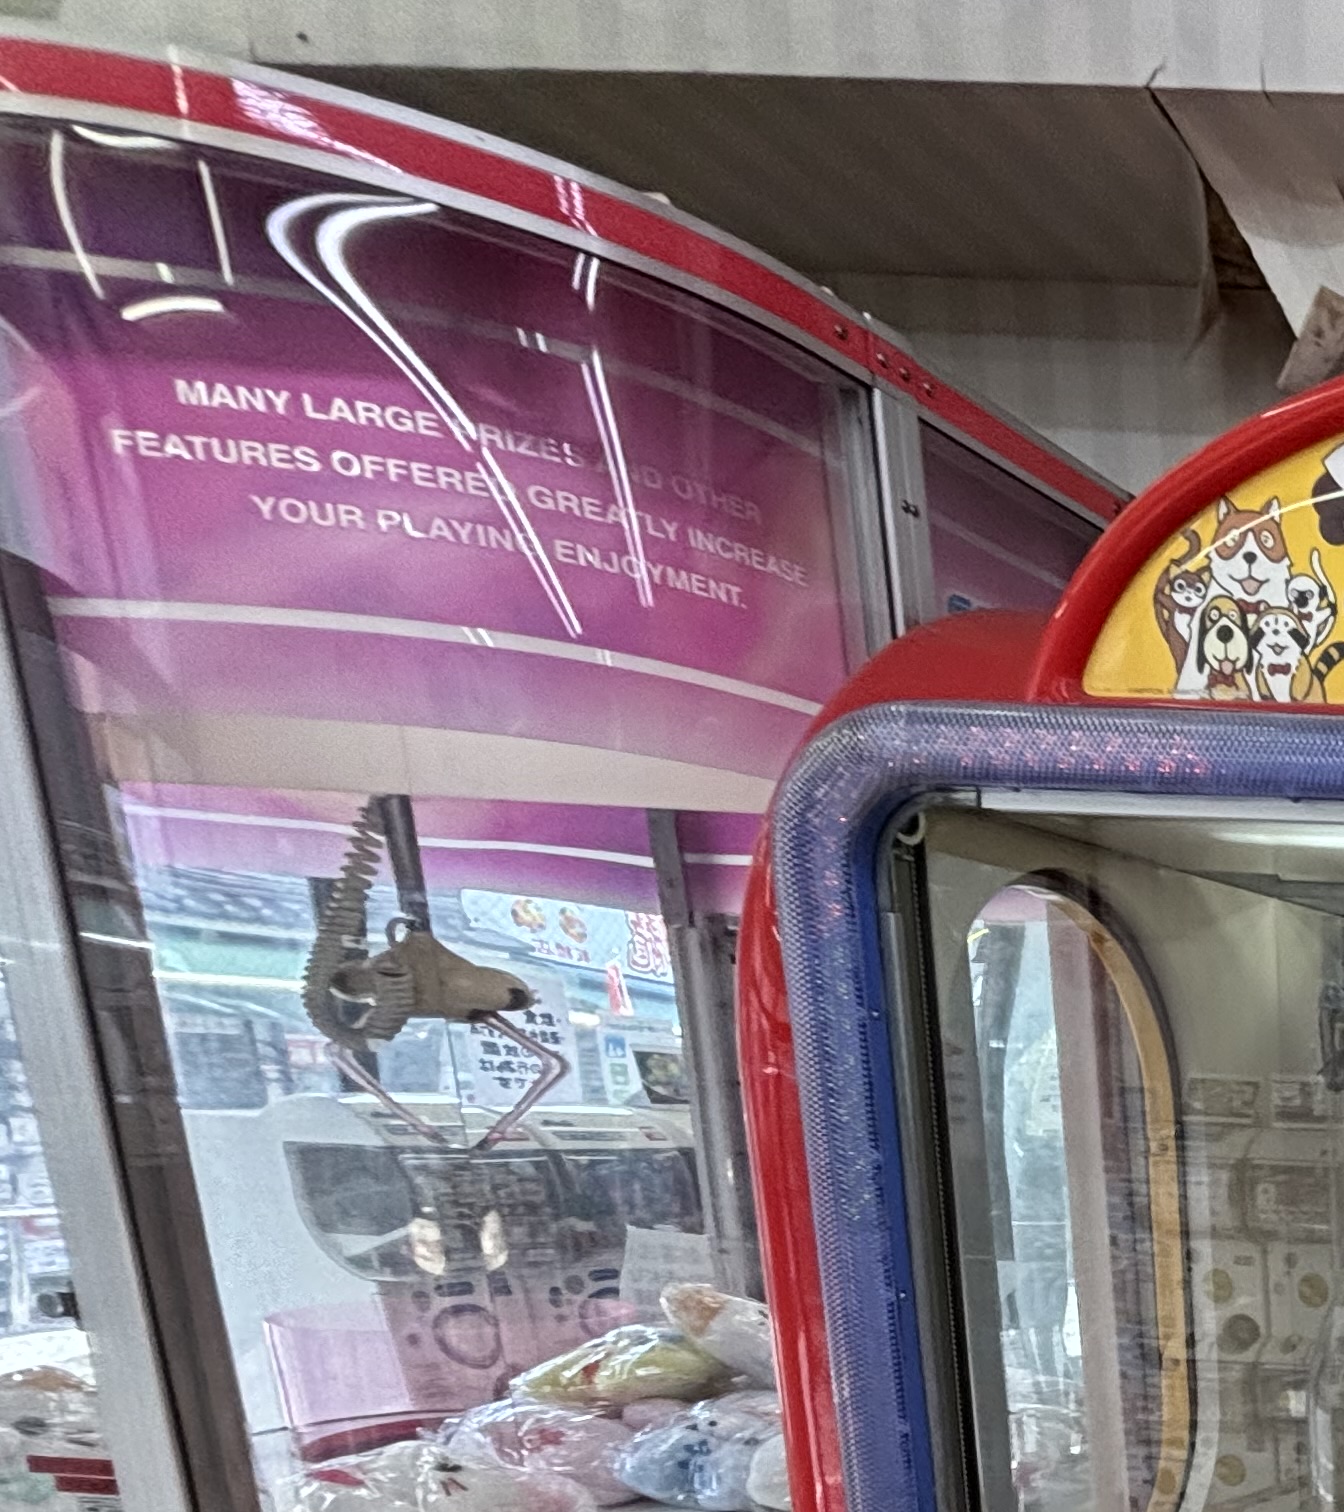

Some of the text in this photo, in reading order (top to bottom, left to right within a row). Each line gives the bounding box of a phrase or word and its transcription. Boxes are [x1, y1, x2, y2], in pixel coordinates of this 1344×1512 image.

[110, 428, 323, 473] FEATURES
[687, 526, 810, 588] INCREASE
[173, 377, 292, 416] MANY
[301, 392, 444, 439] LARGE
[671, 471, 762, 525] OTHER
[248, 494, 367, 531] YOUR
[553, 539, 748, 609] ENJOYMENT.
